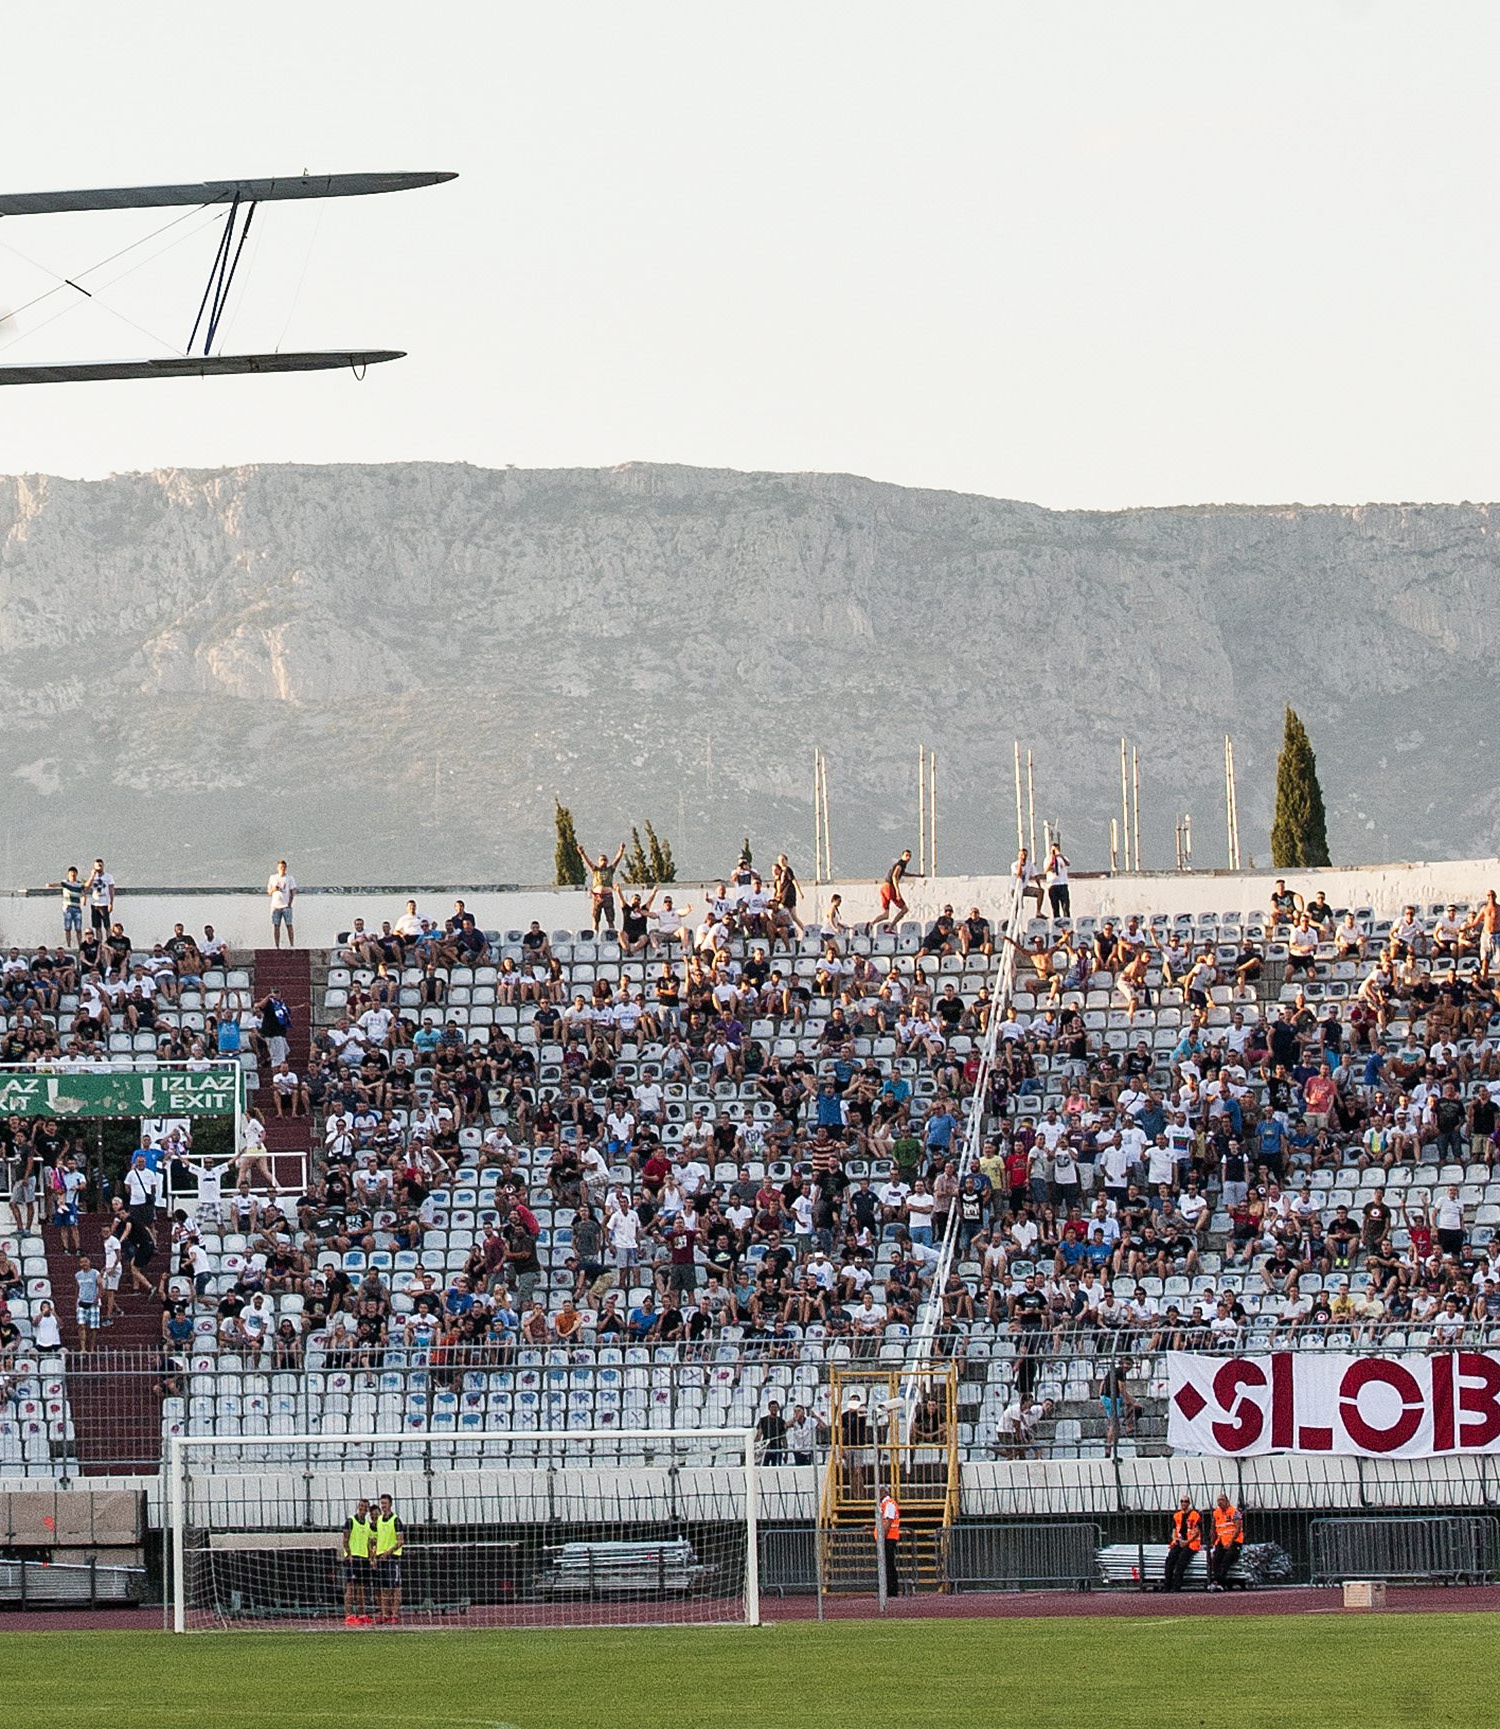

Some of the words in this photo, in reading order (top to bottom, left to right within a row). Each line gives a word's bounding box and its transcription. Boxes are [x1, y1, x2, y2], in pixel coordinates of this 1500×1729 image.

[161, 1076, 235, 1091] IZLAZ
[170, 1093, 227, 1109] EXIT
[1212, 1352, 1500, 1453] SLOB
